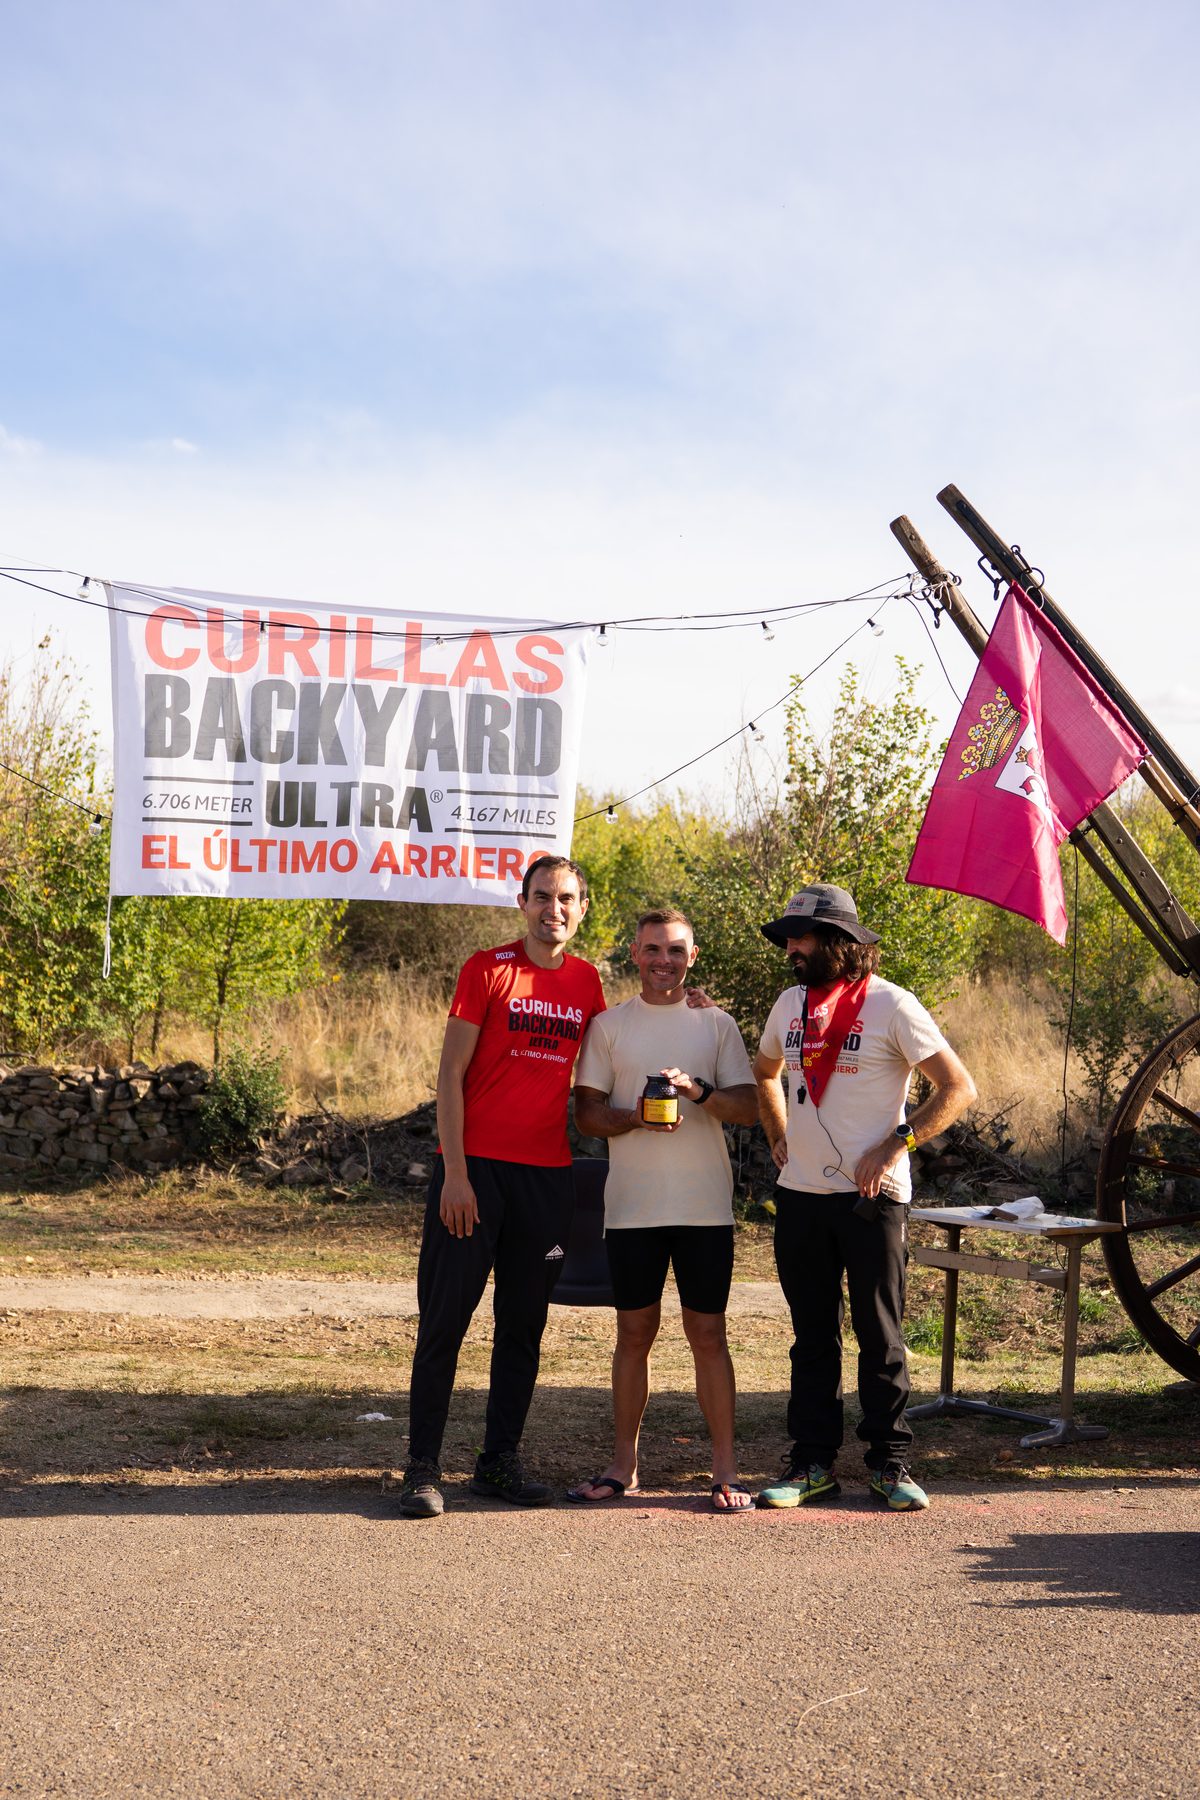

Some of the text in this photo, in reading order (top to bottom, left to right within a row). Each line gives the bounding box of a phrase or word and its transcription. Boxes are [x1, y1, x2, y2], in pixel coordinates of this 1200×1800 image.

[145, 604, 565, 694] CURILLAS
[144, 674, 563, 777] BACKYARD
[142, 793, 252, 813] 6.706 METER
[450, 806, 557, 826] 4.167 MILES
[142, 834, 190, 869] EL
[203, 829, 359, 874] ÚLTIMO
[509, 997, 583, 1024] CURILLAS
[508, 1013, 581, 1041] BACKYARD
[511, 1049, 519, 1057] EL
